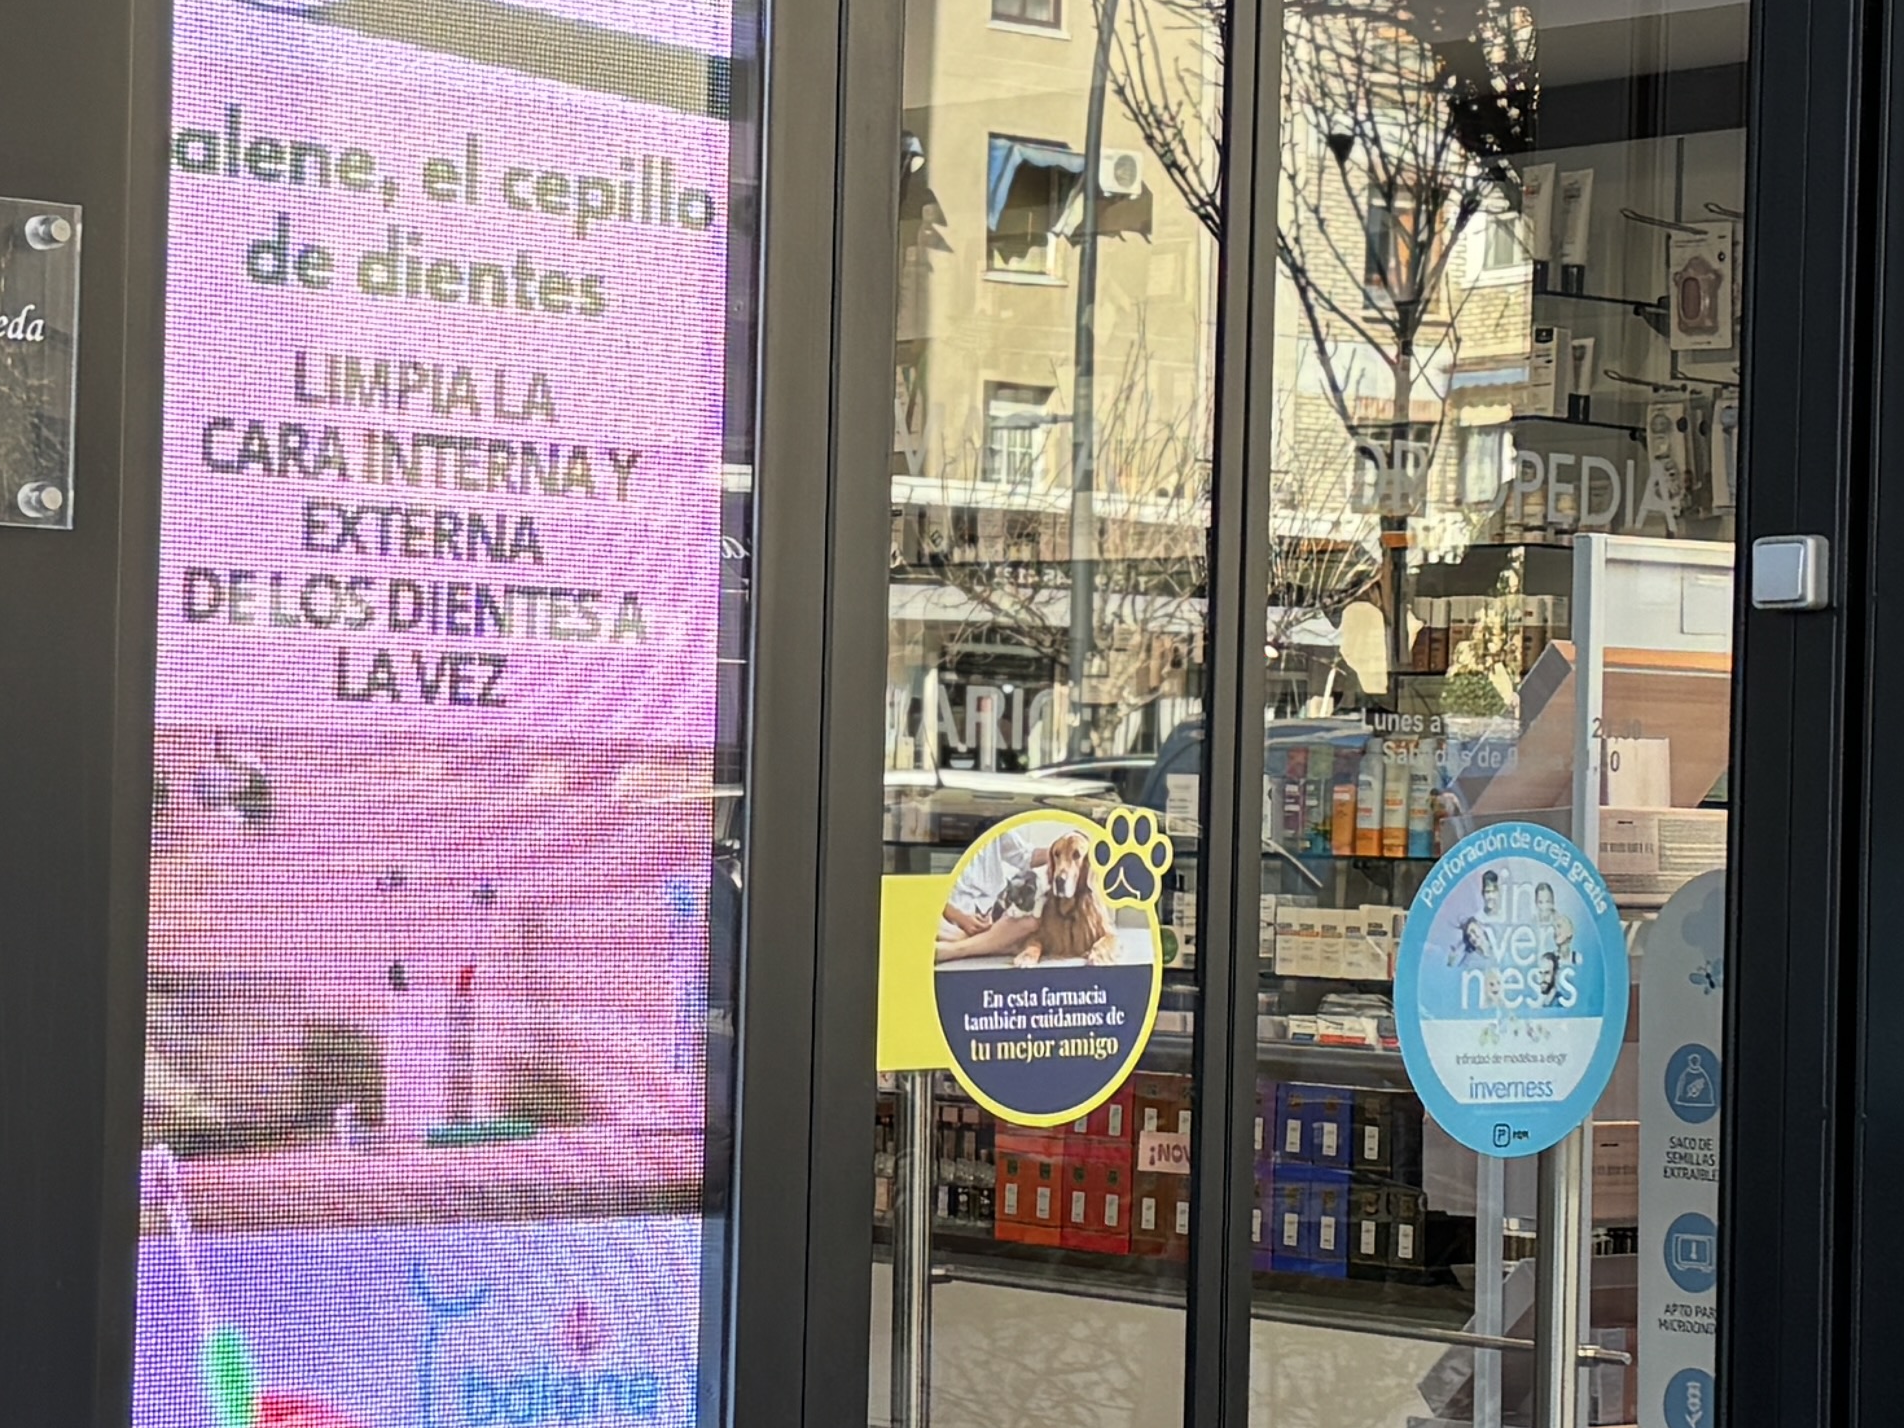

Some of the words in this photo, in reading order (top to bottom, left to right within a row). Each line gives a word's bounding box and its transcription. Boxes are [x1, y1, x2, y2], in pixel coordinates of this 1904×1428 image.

[172, 103, 399, 209] alene,
[421, 133, 480, 206] el
[502, 152, 716, 238] cepillo
[247, 213, 335, 290] de
[358, 225, 608, 317] dientes
[294, 350, 482, 419] LIMPIA
[497, 367, 557, 421] LA
[201, 416, 349, 482] CARA
[362, 429, 596, 500] INTERNA
[610, 447, 643, 501] Y
[302, 502, 546, 565] EXTERNA
[183, 567, 256, 624] DE
[270, 572, 374, 629] LOS
[389, 579, 602, 643] DIENTES
[613, 590, 647, 643] A
[336, 647, 401, 703] LA
[412, 652, 508, 708] VEZ
[1510, 827, 1531, 850] de
[1535, 832, 1573, 868] oreja
[1571, 860, 1608, 915] gratis
[964, 1012, 1027, 1031] también
[1030, 1009, 1103, 1028] cuidamos
[1106, 1008, 1124, 1026] de
[983, 990, 1002, 1008] En
[1006, 989, 1037, 1007] esta
[1041, 985, 1106, 1007] farmacia
[971, 1041, 991, 1061] tu
[996, 1039, 1055, 1063] mejor
[1058, 1032, 1119, 1060] amigo
[1469, 1076, 1554, 1099] inverness
[1666, 1151, 1716, 1166] SEMILLAS
[1669, 1136, 1696, 1150] SACO
[1698, 1138, 1713, 1151] DE
